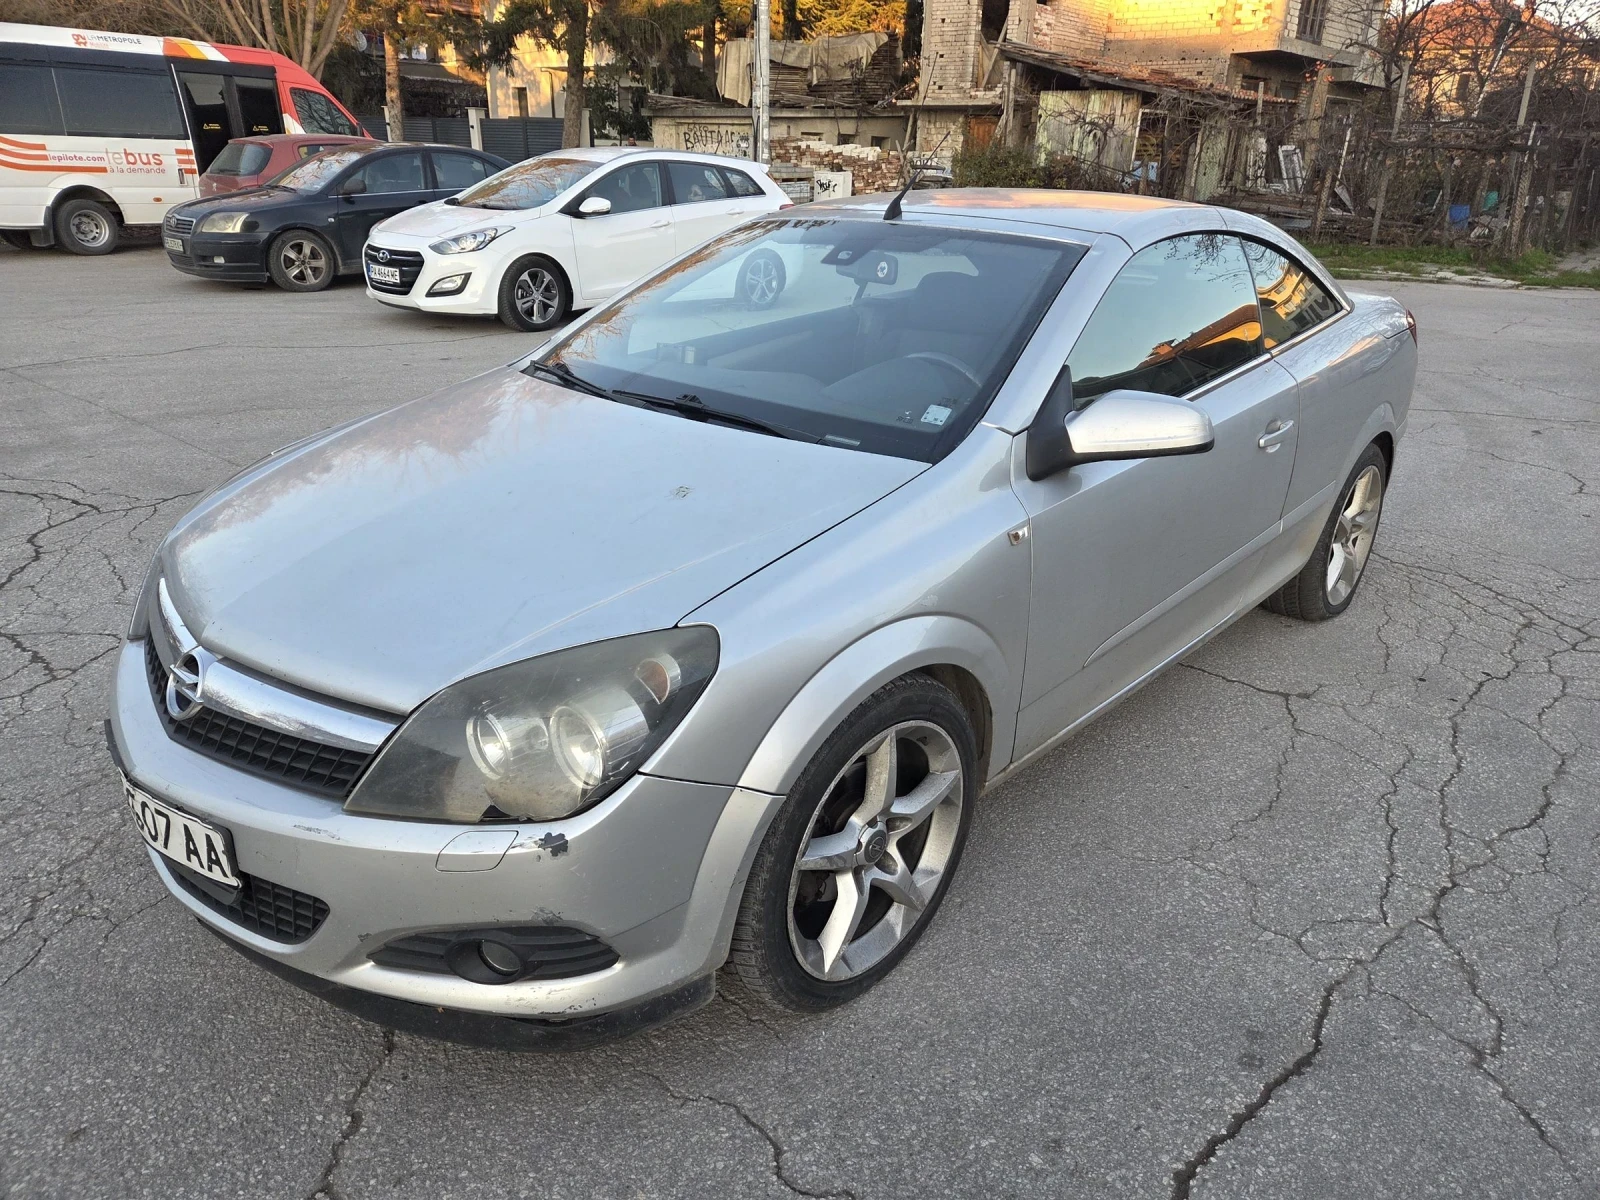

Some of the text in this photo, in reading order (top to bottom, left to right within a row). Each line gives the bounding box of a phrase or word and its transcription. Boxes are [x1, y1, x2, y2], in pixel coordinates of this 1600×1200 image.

[49, 154, 106, 163] lepilote.com
[126, 166, 166, 174] demande
[183, 823, 229, 879] AA
